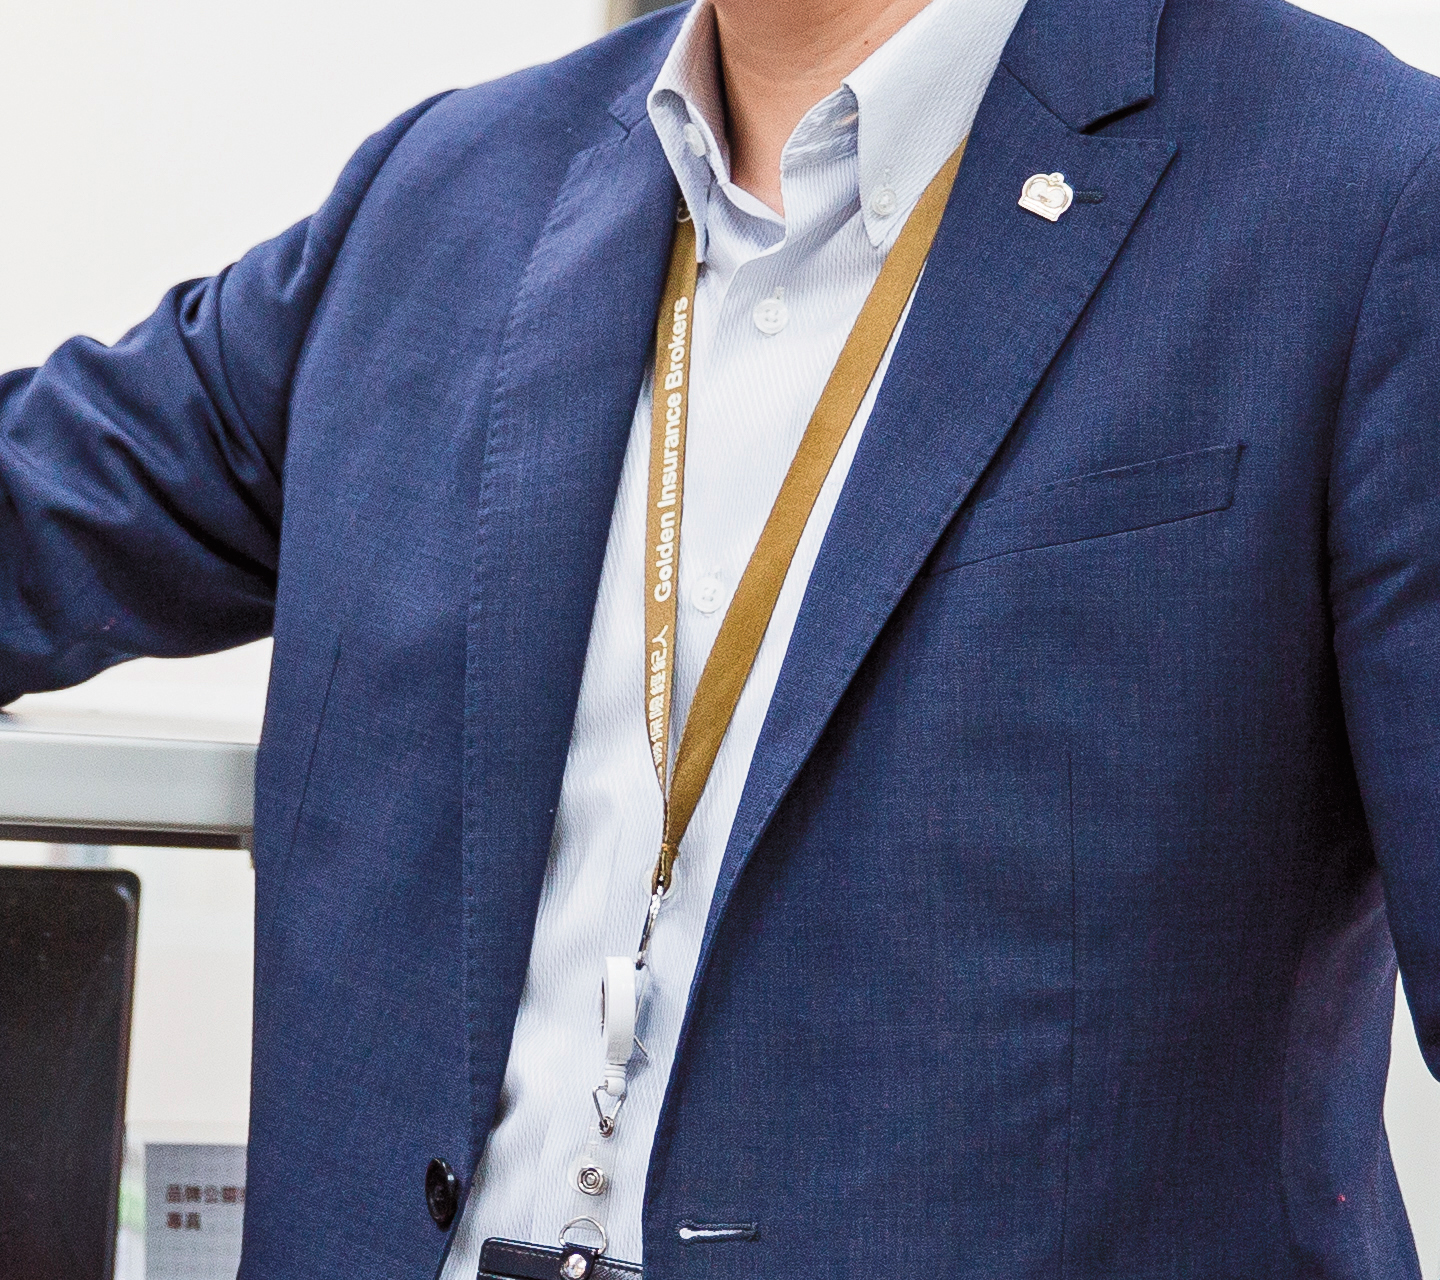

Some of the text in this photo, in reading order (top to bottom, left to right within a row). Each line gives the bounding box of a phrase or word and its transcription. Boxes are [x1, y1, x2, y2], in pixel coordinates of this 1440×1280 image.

[653, 296, 689, 603] Golden Insurance Brokers
